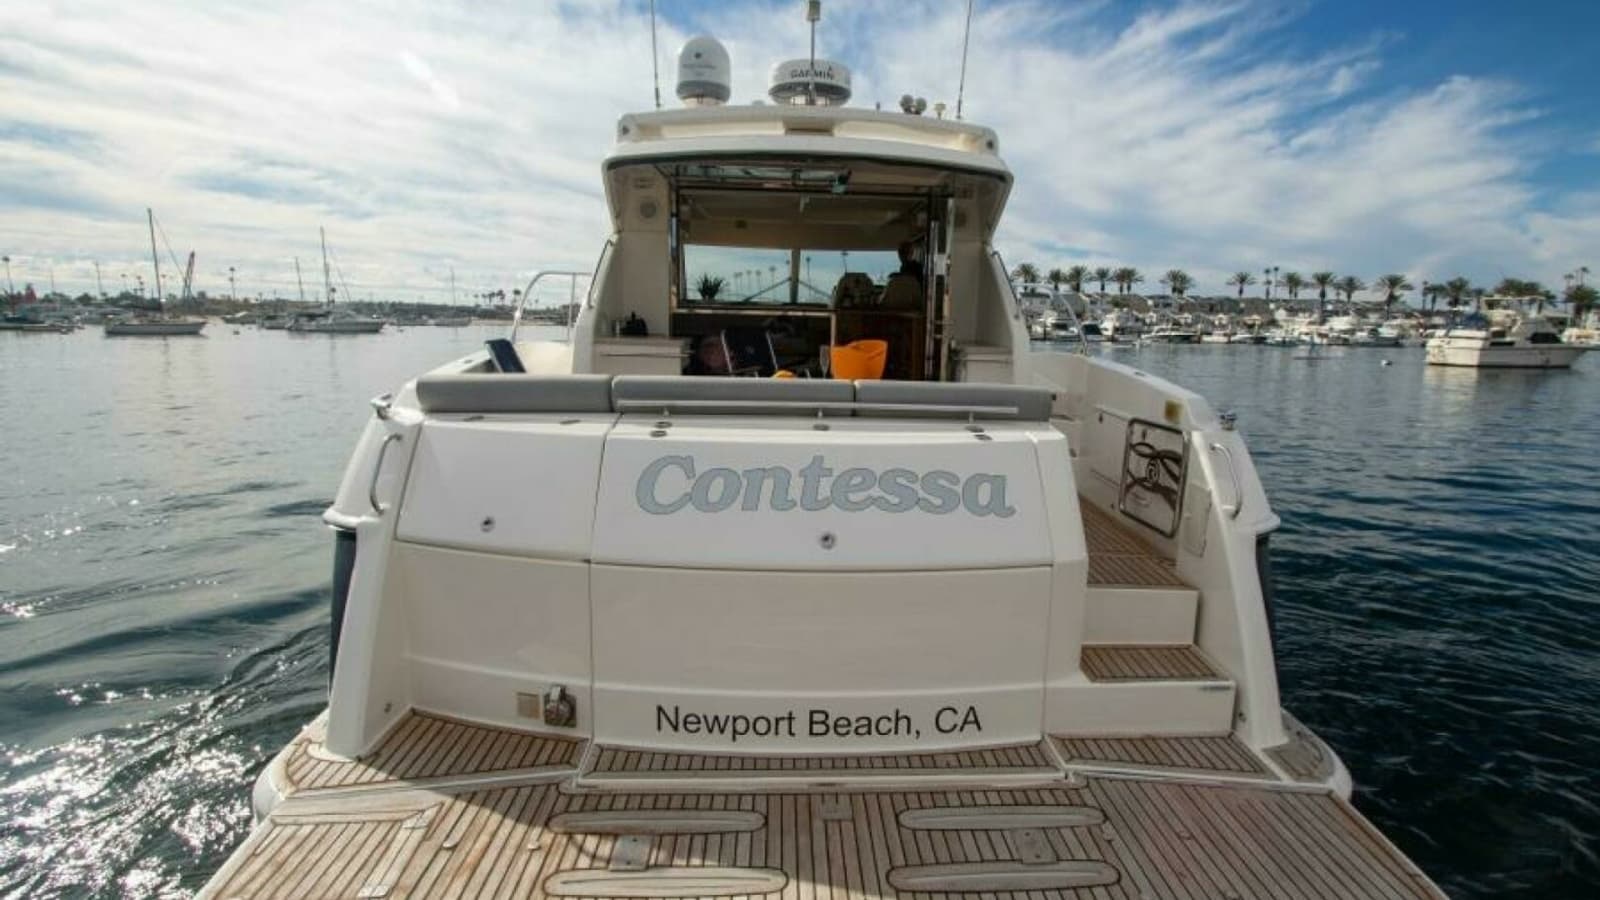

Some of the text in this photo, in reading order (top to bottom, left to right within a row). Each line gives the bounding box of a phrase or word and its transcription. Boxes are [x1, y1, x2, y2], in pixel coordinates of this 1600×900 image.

[636, 455, 1016, 518] Contessa
[656, 705, 982, 742] Newport Beach, CA
